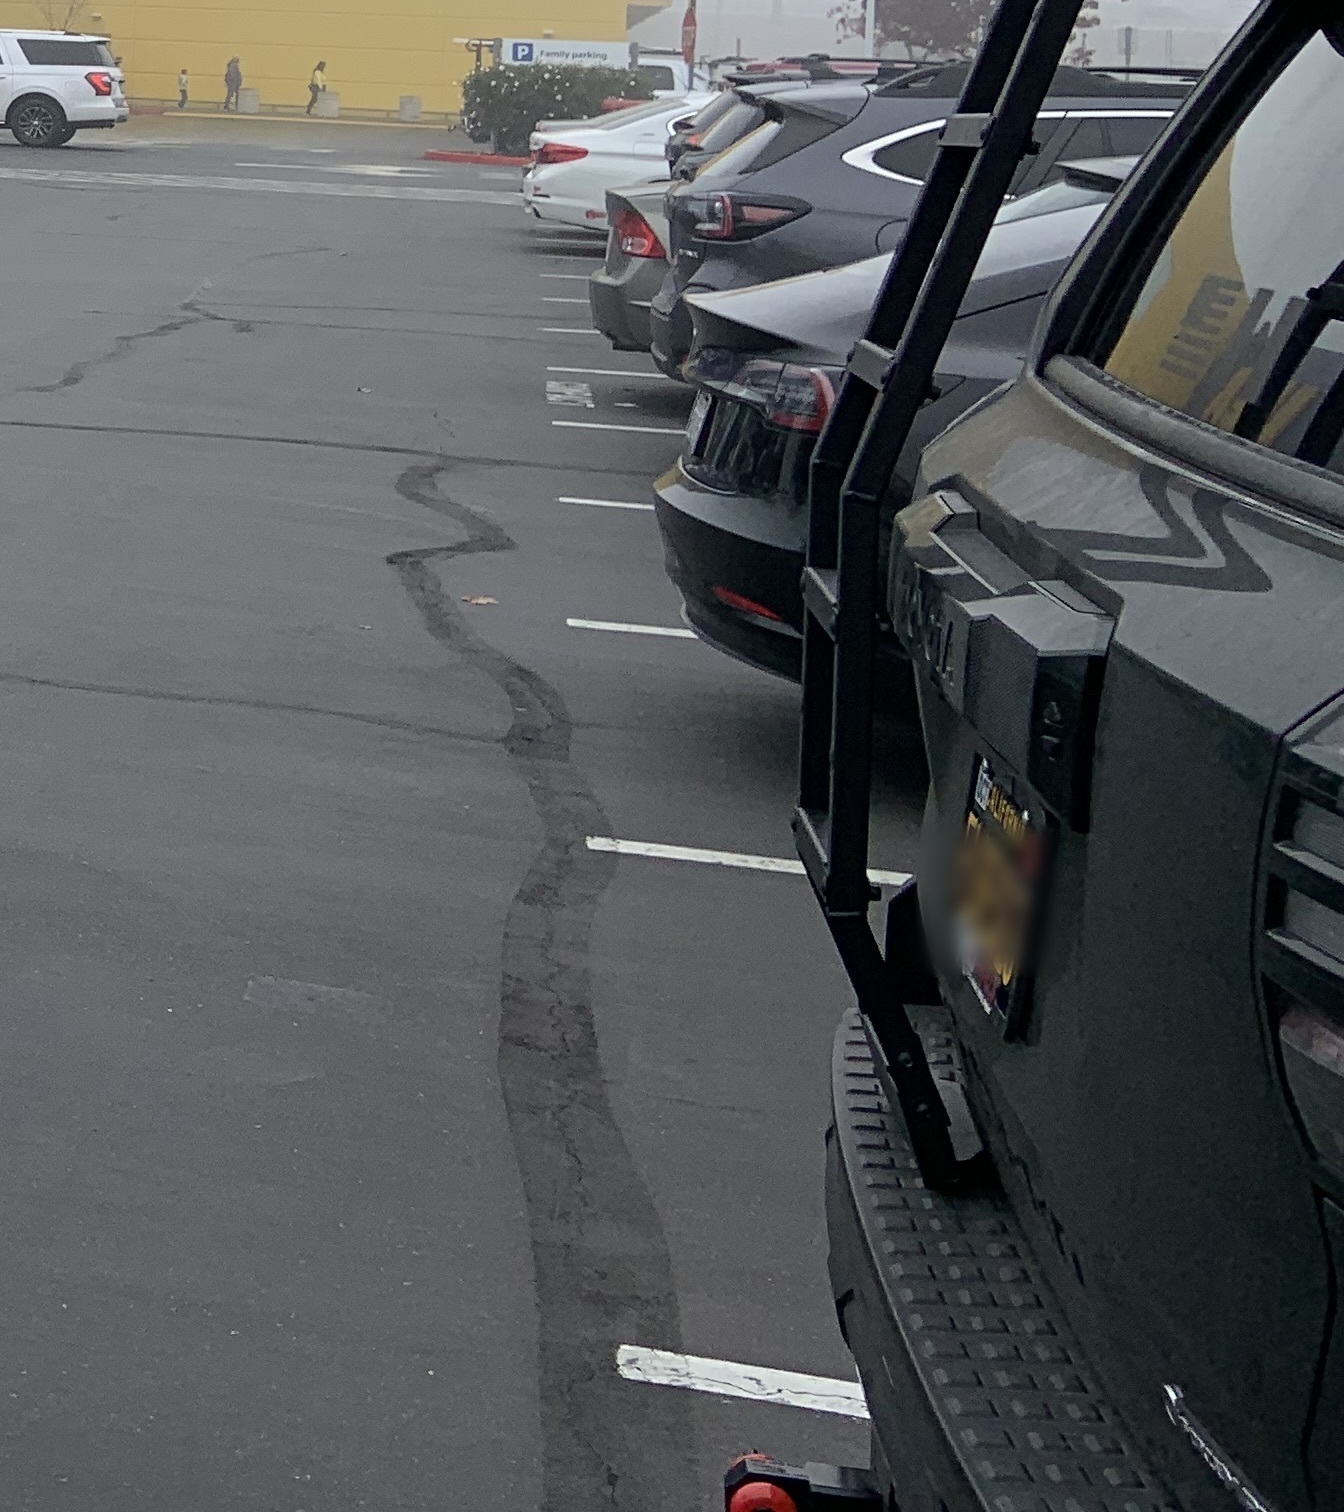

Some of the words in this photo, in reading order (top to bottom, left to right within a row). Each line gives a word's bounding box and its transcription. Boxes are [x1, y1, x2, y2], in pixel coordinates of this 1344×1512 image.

[517, 45, 530, 60] P
[540, 50, 570, 60] Family
[572, 51, 608, 61] parking
